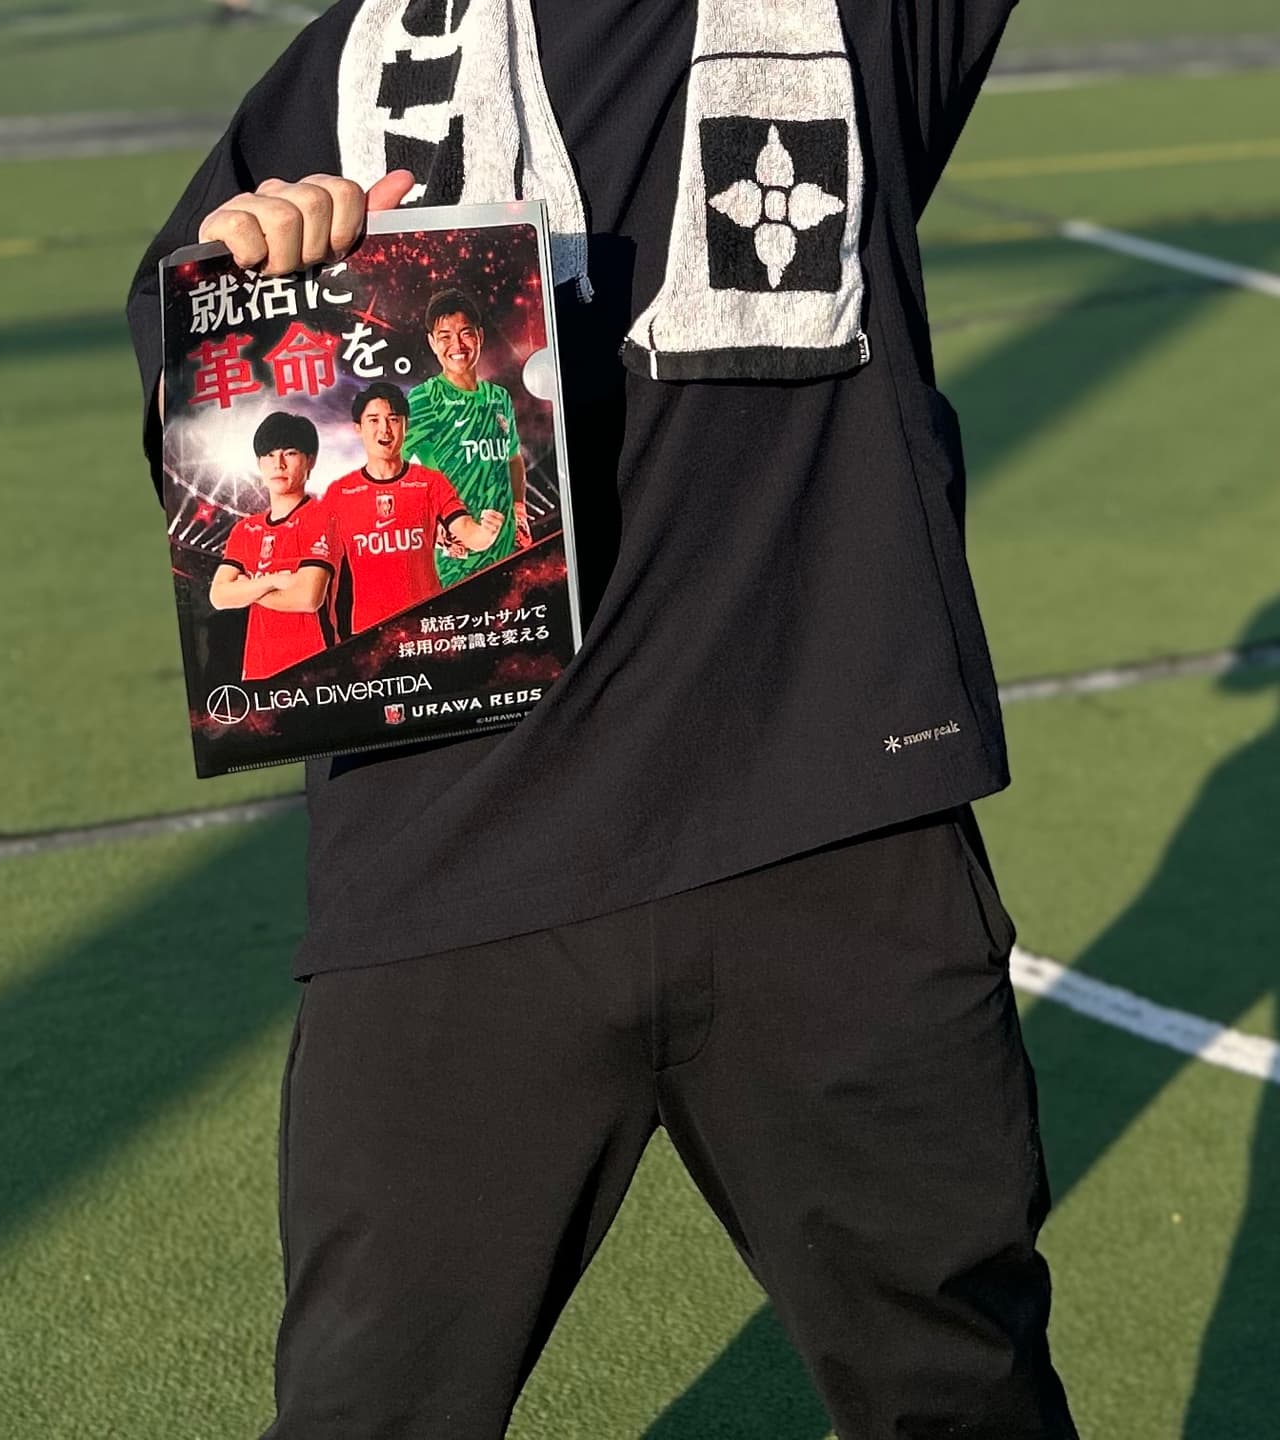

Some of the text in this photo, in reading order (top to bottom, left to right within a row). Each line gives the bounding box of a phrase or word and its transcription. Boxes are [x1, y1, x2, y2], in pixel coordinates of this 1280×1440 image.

[188, 263, 353, 334] 就活に
[187, 321, 411, 409] 革命を。
[353, 527, 424, 557] POLUS
[420, 604, 548, 634] 就活フットサルで
[398, 625, 550, 658] 採用の常識を変える
[411, 688, 542, 718] URAWA REDS
